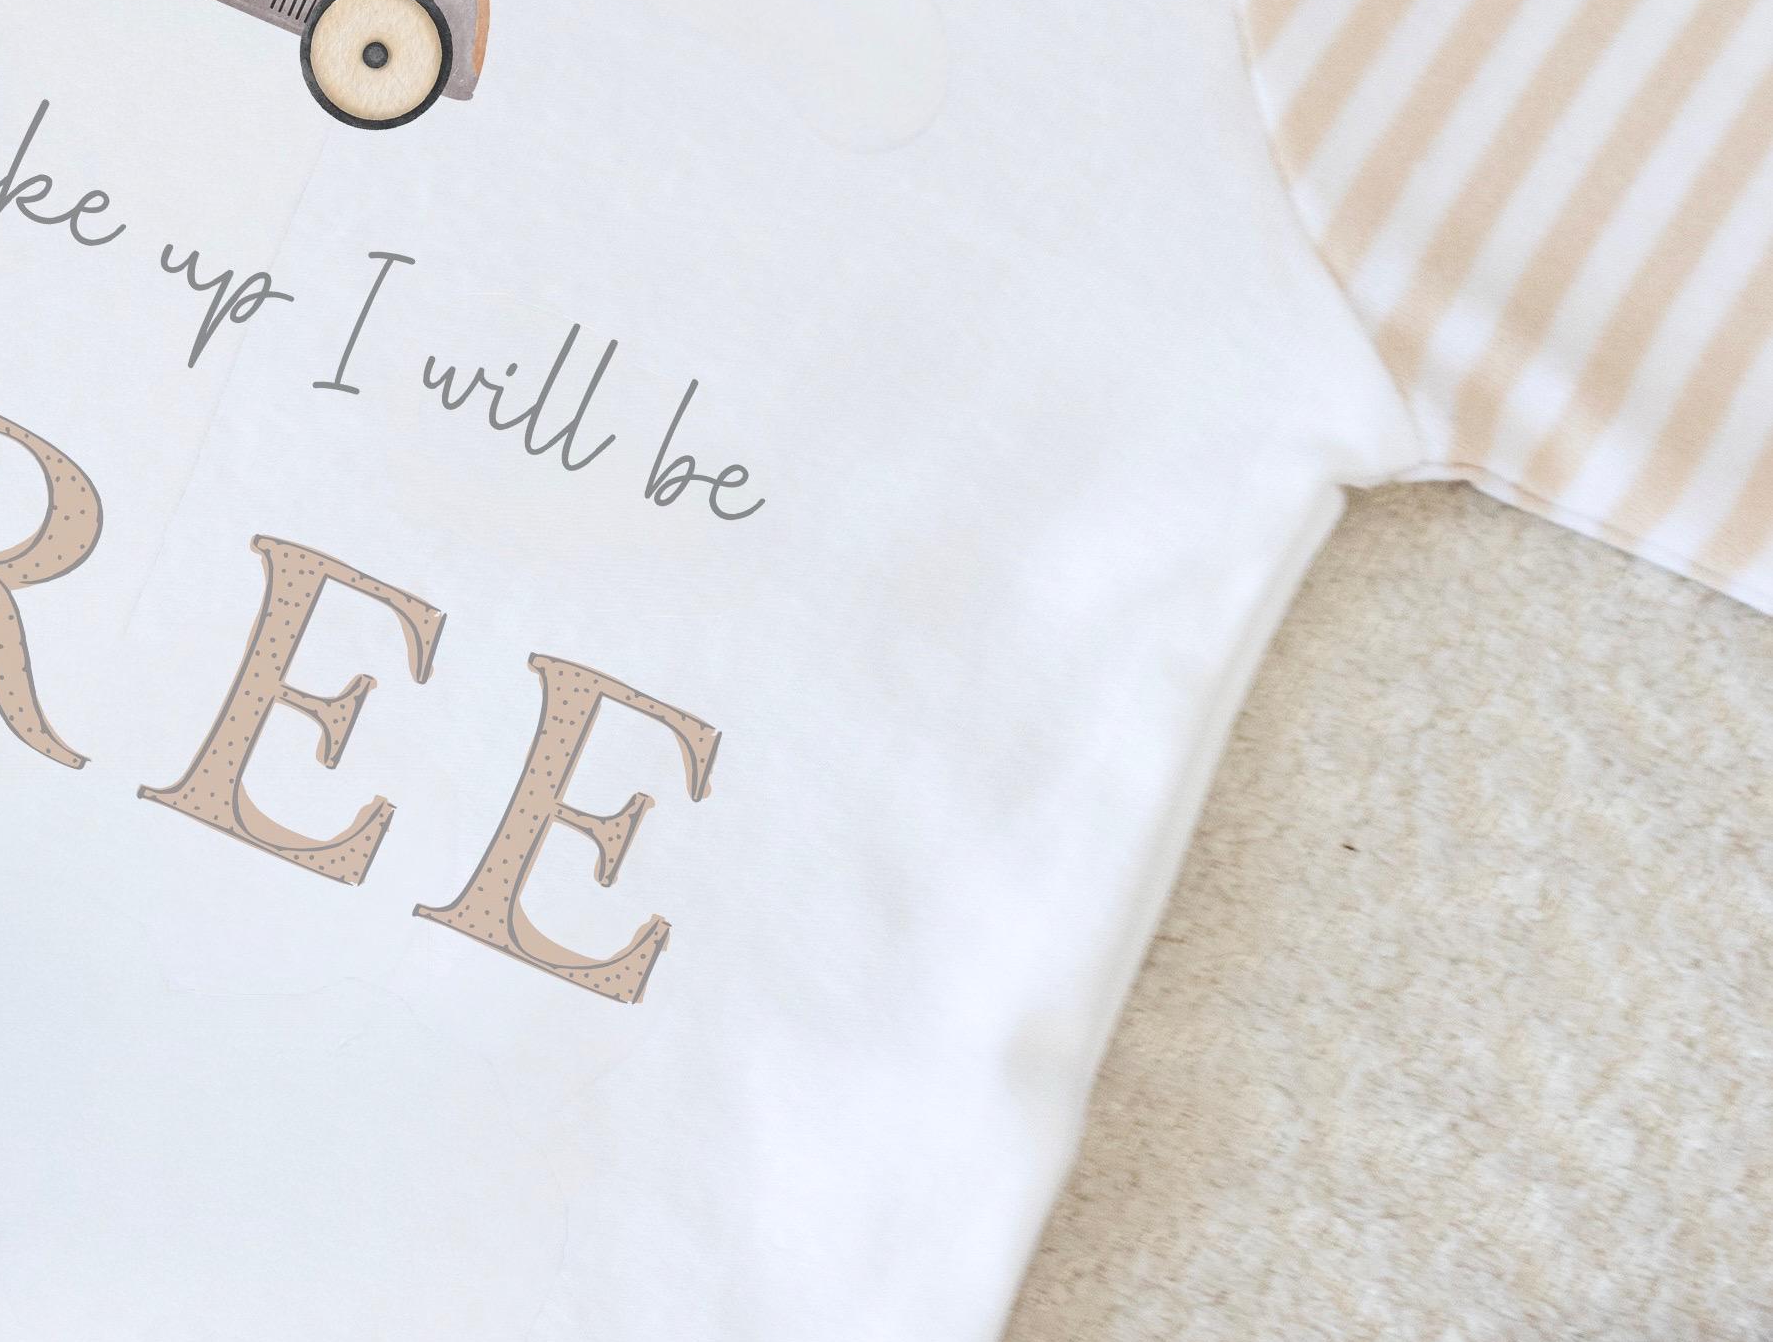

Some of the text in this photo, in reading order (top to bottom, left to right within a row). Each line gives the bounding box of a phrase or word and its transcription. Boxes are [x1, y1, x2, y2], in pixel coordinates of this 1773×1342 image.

[161, 244, 294, 368] up
[313, 252, 415, 395] I
[423, 323, 618, 471] will
[645, 379, 765, 520] be
